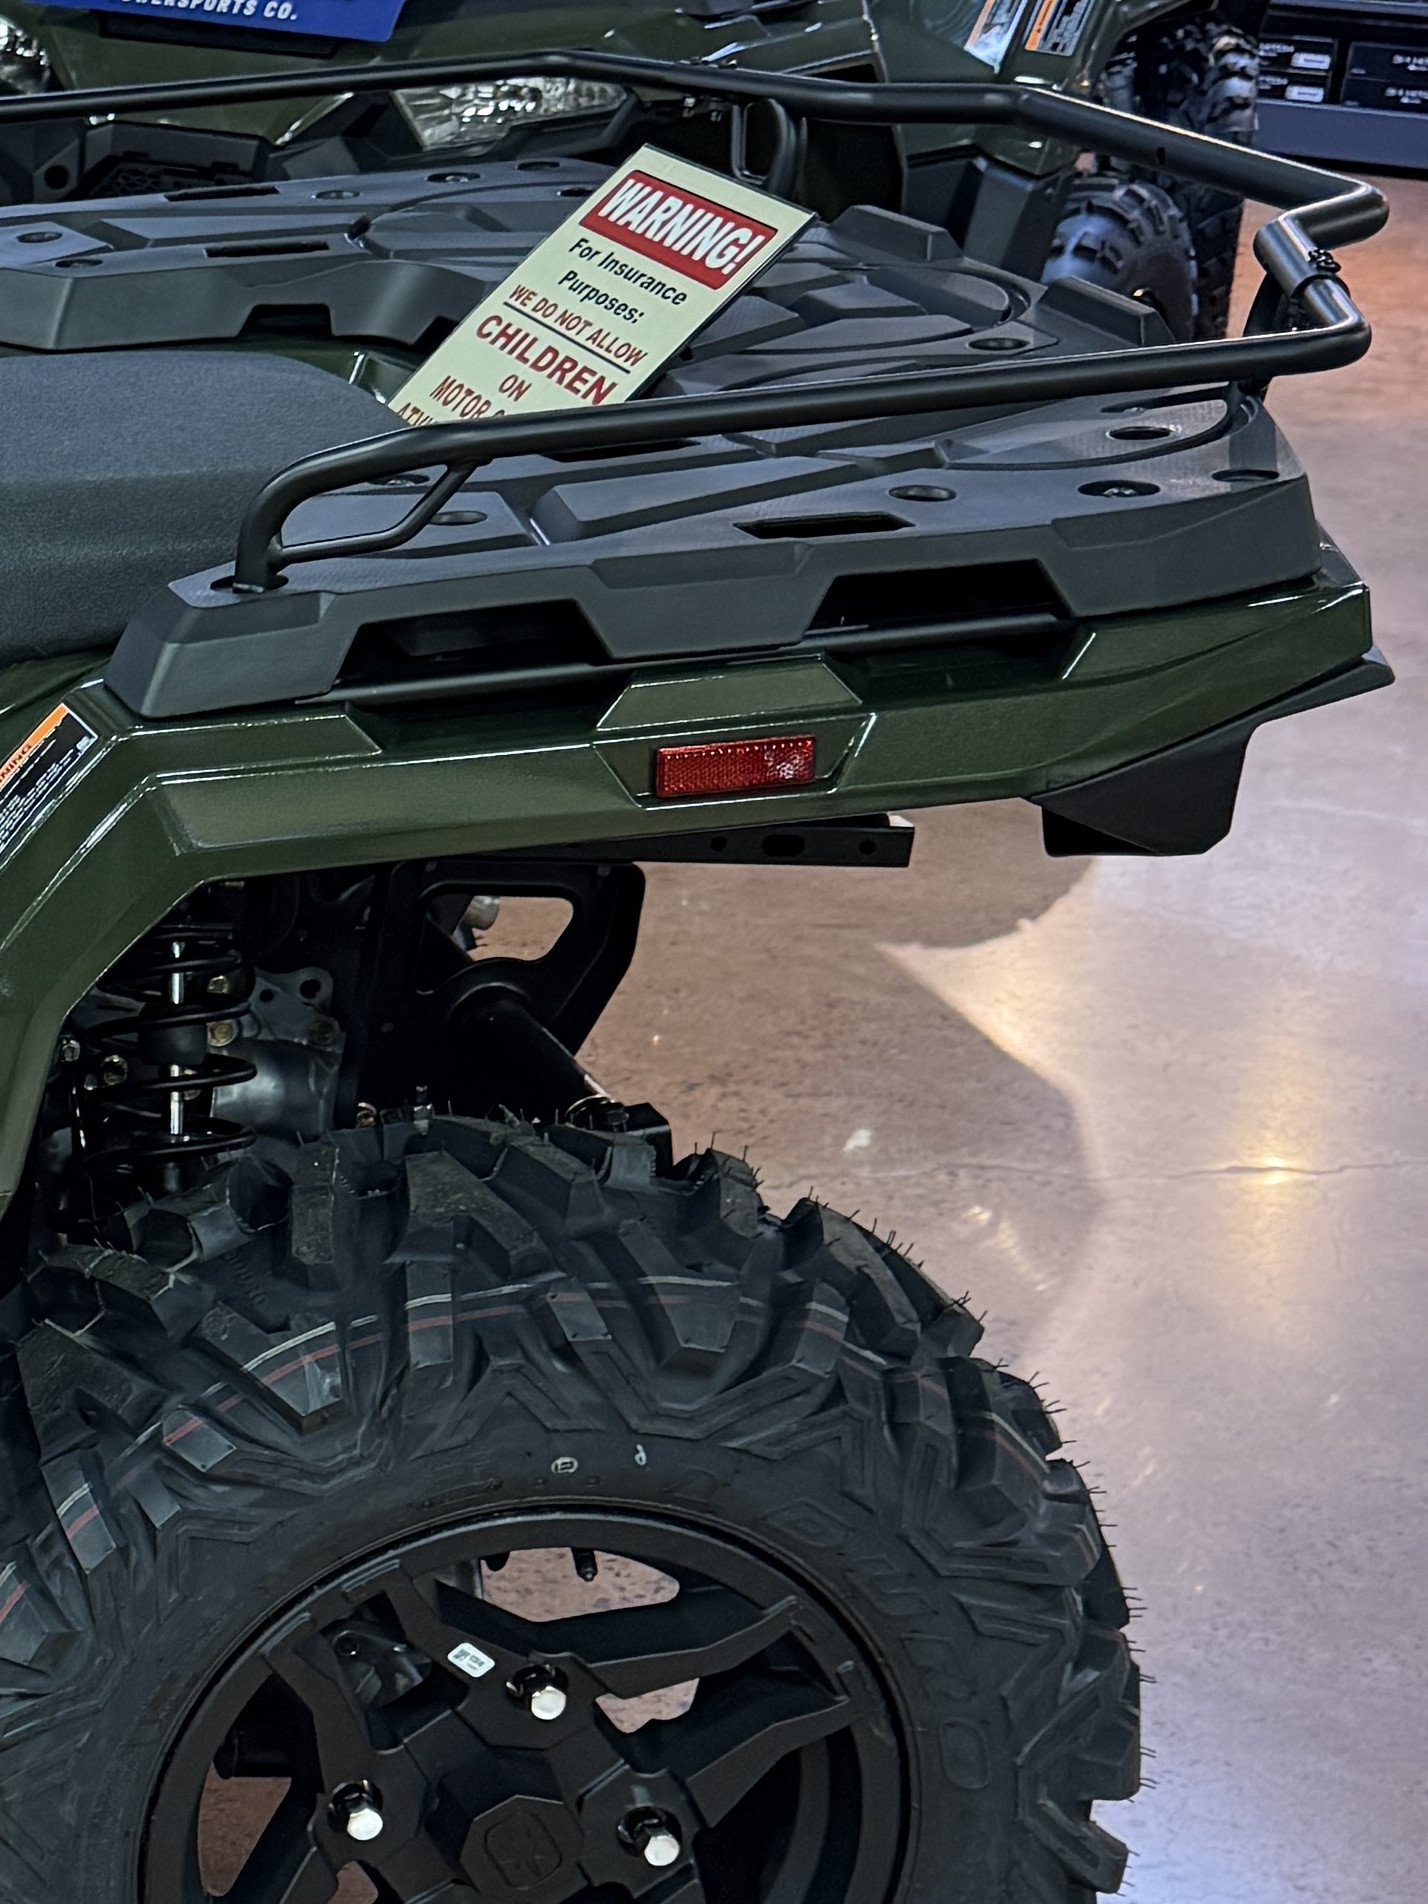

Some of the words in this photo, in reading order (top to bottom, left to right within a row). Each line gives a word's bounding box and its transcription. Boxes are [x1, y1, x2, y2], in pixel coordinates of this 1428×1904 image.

[264, 0, 298, 22] CO.
[599, 178, 765, 275] WARNING!
[559, 270, 645, 325] Purposes;
[569, 238, 601, 269] For
[602, 251, 687, 306] Insurance
[509, 284, 538, 307] WE
[531, 297, 558, 319] DO
[555, 309, 593, 336] NOT
[585, 328, 648, 368] ALLOW
[476, 314, 618, 406] CHILDREN
[498, 374, 532, 402] ON
[430, 375, 492, 419] MOTOR
